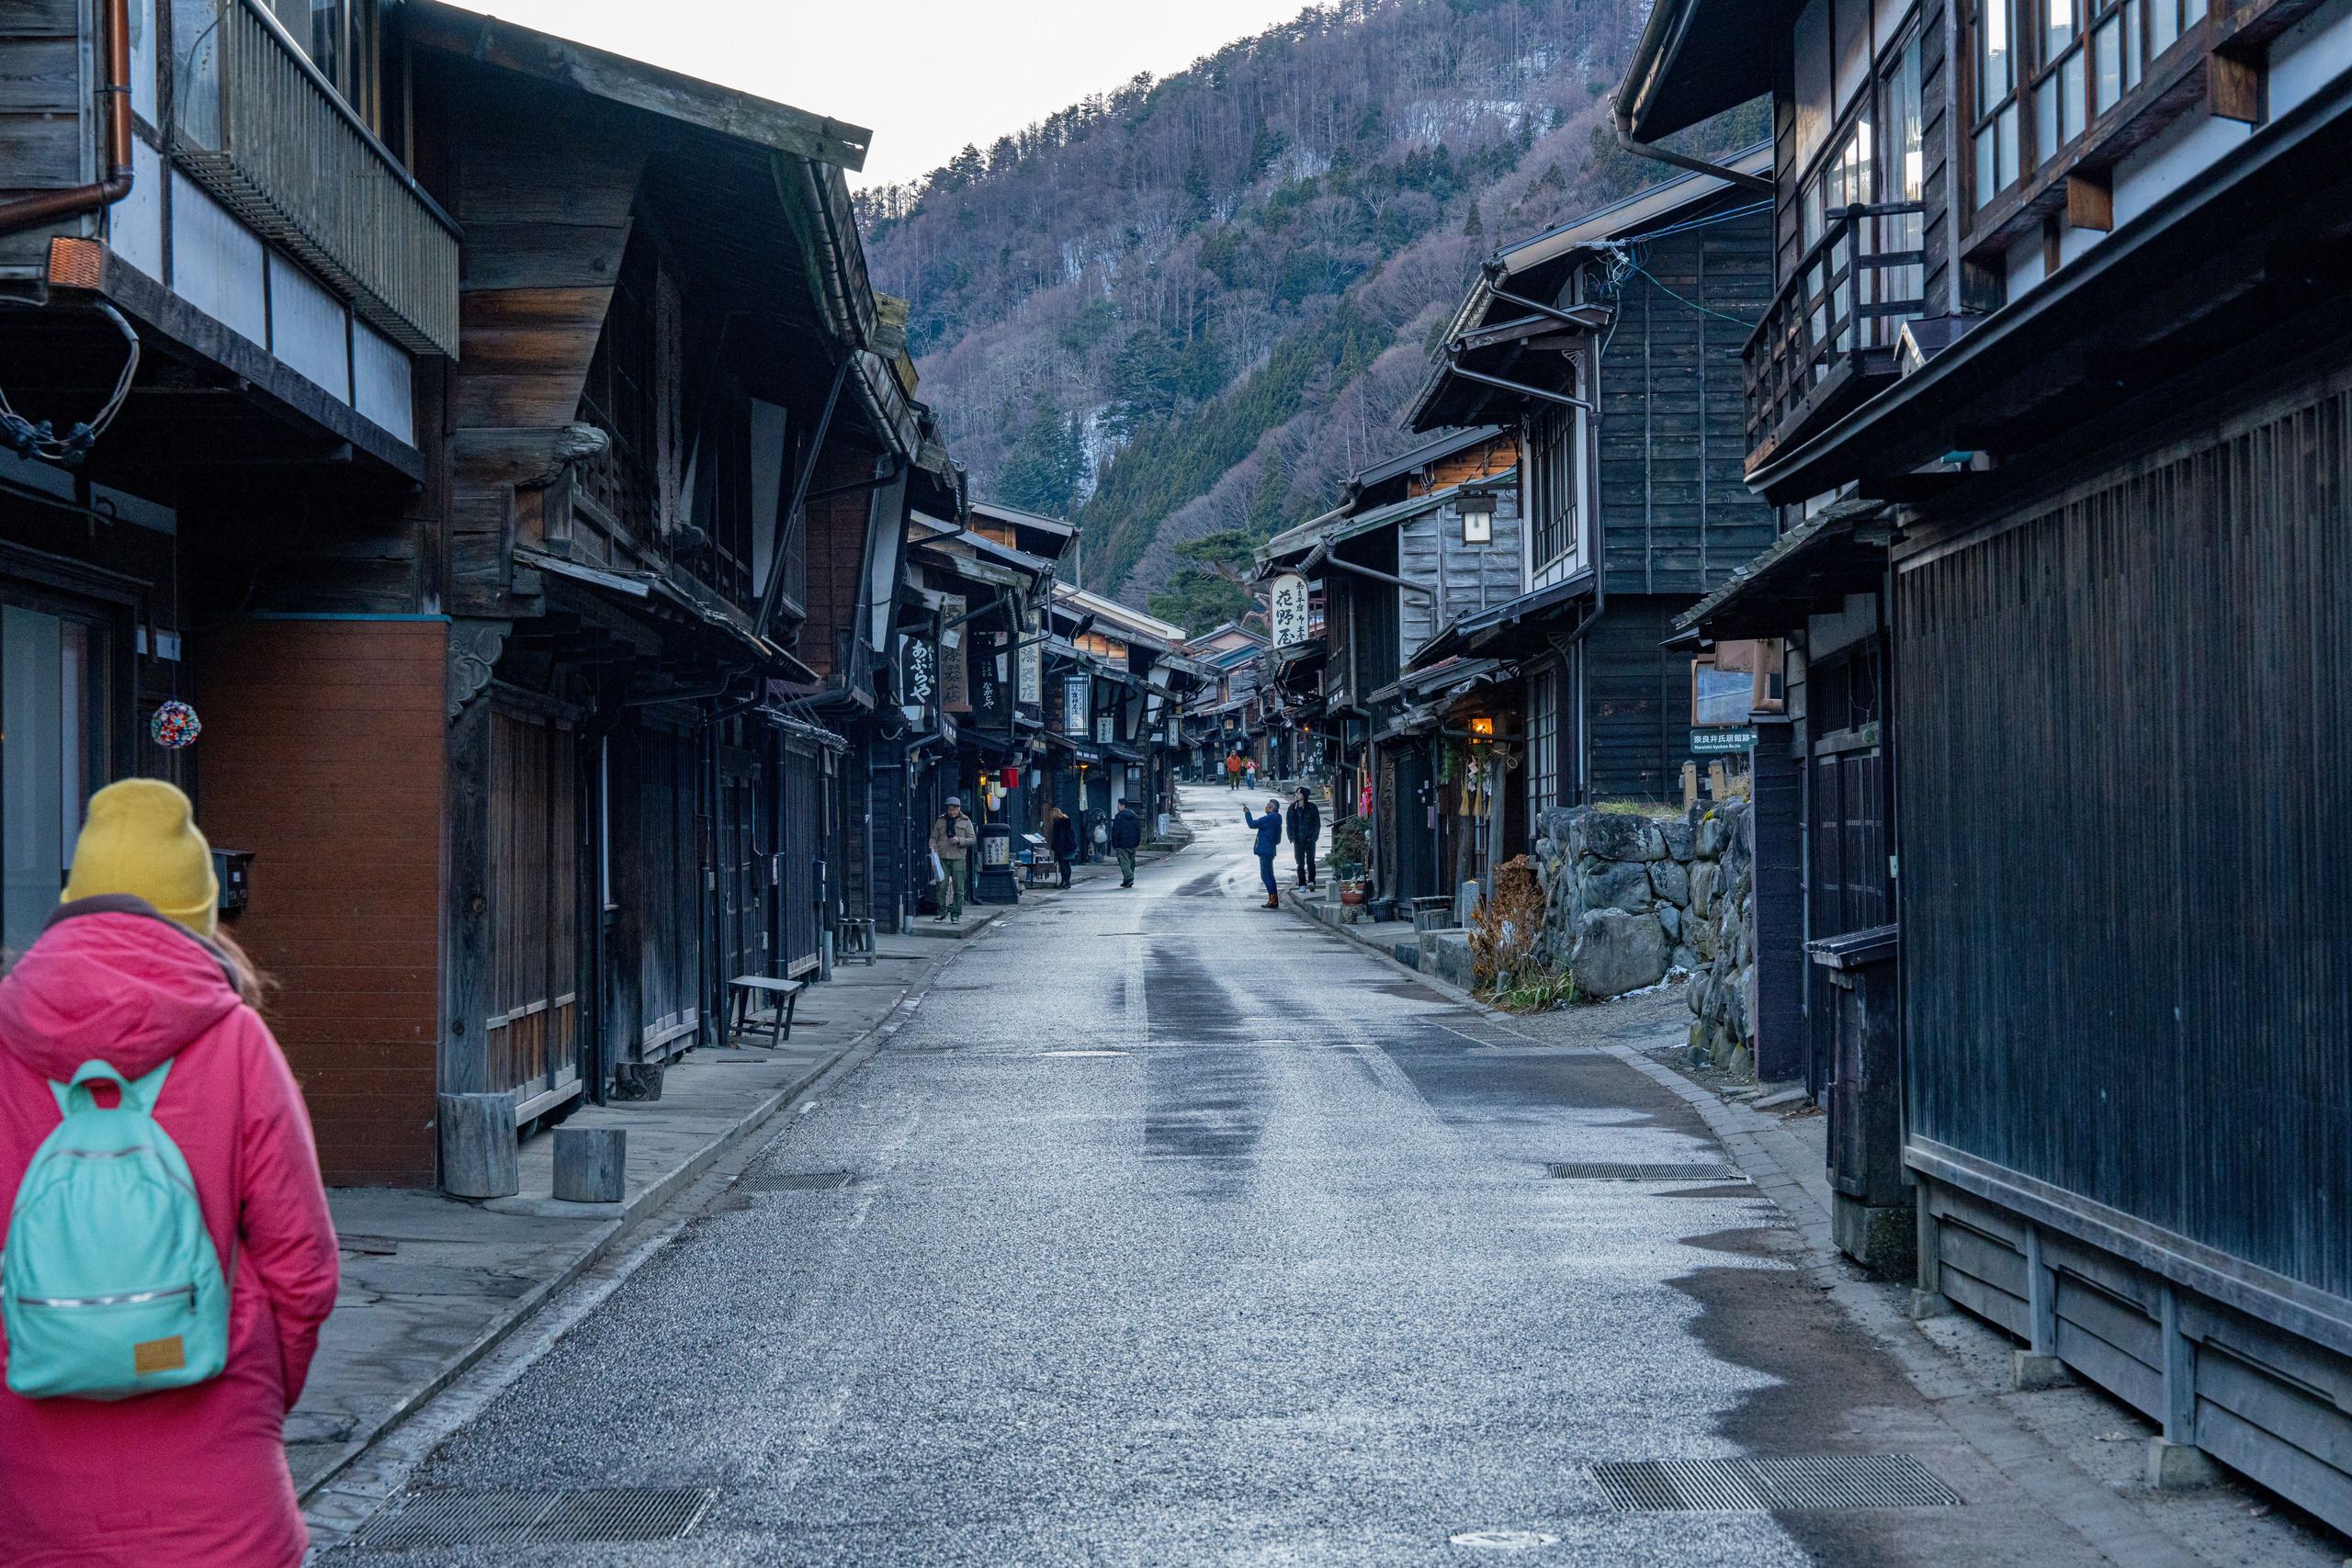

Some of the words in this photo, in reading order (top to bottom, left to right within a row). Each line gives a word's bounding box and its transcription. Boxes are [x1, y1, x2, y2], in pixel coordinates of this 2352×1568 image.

[1275, 589, 1295, 646] 花野屋
[910, 639, 932, 704] あぶらや
[1693, 734, 1750, 744] 奈良井氏居館跡
